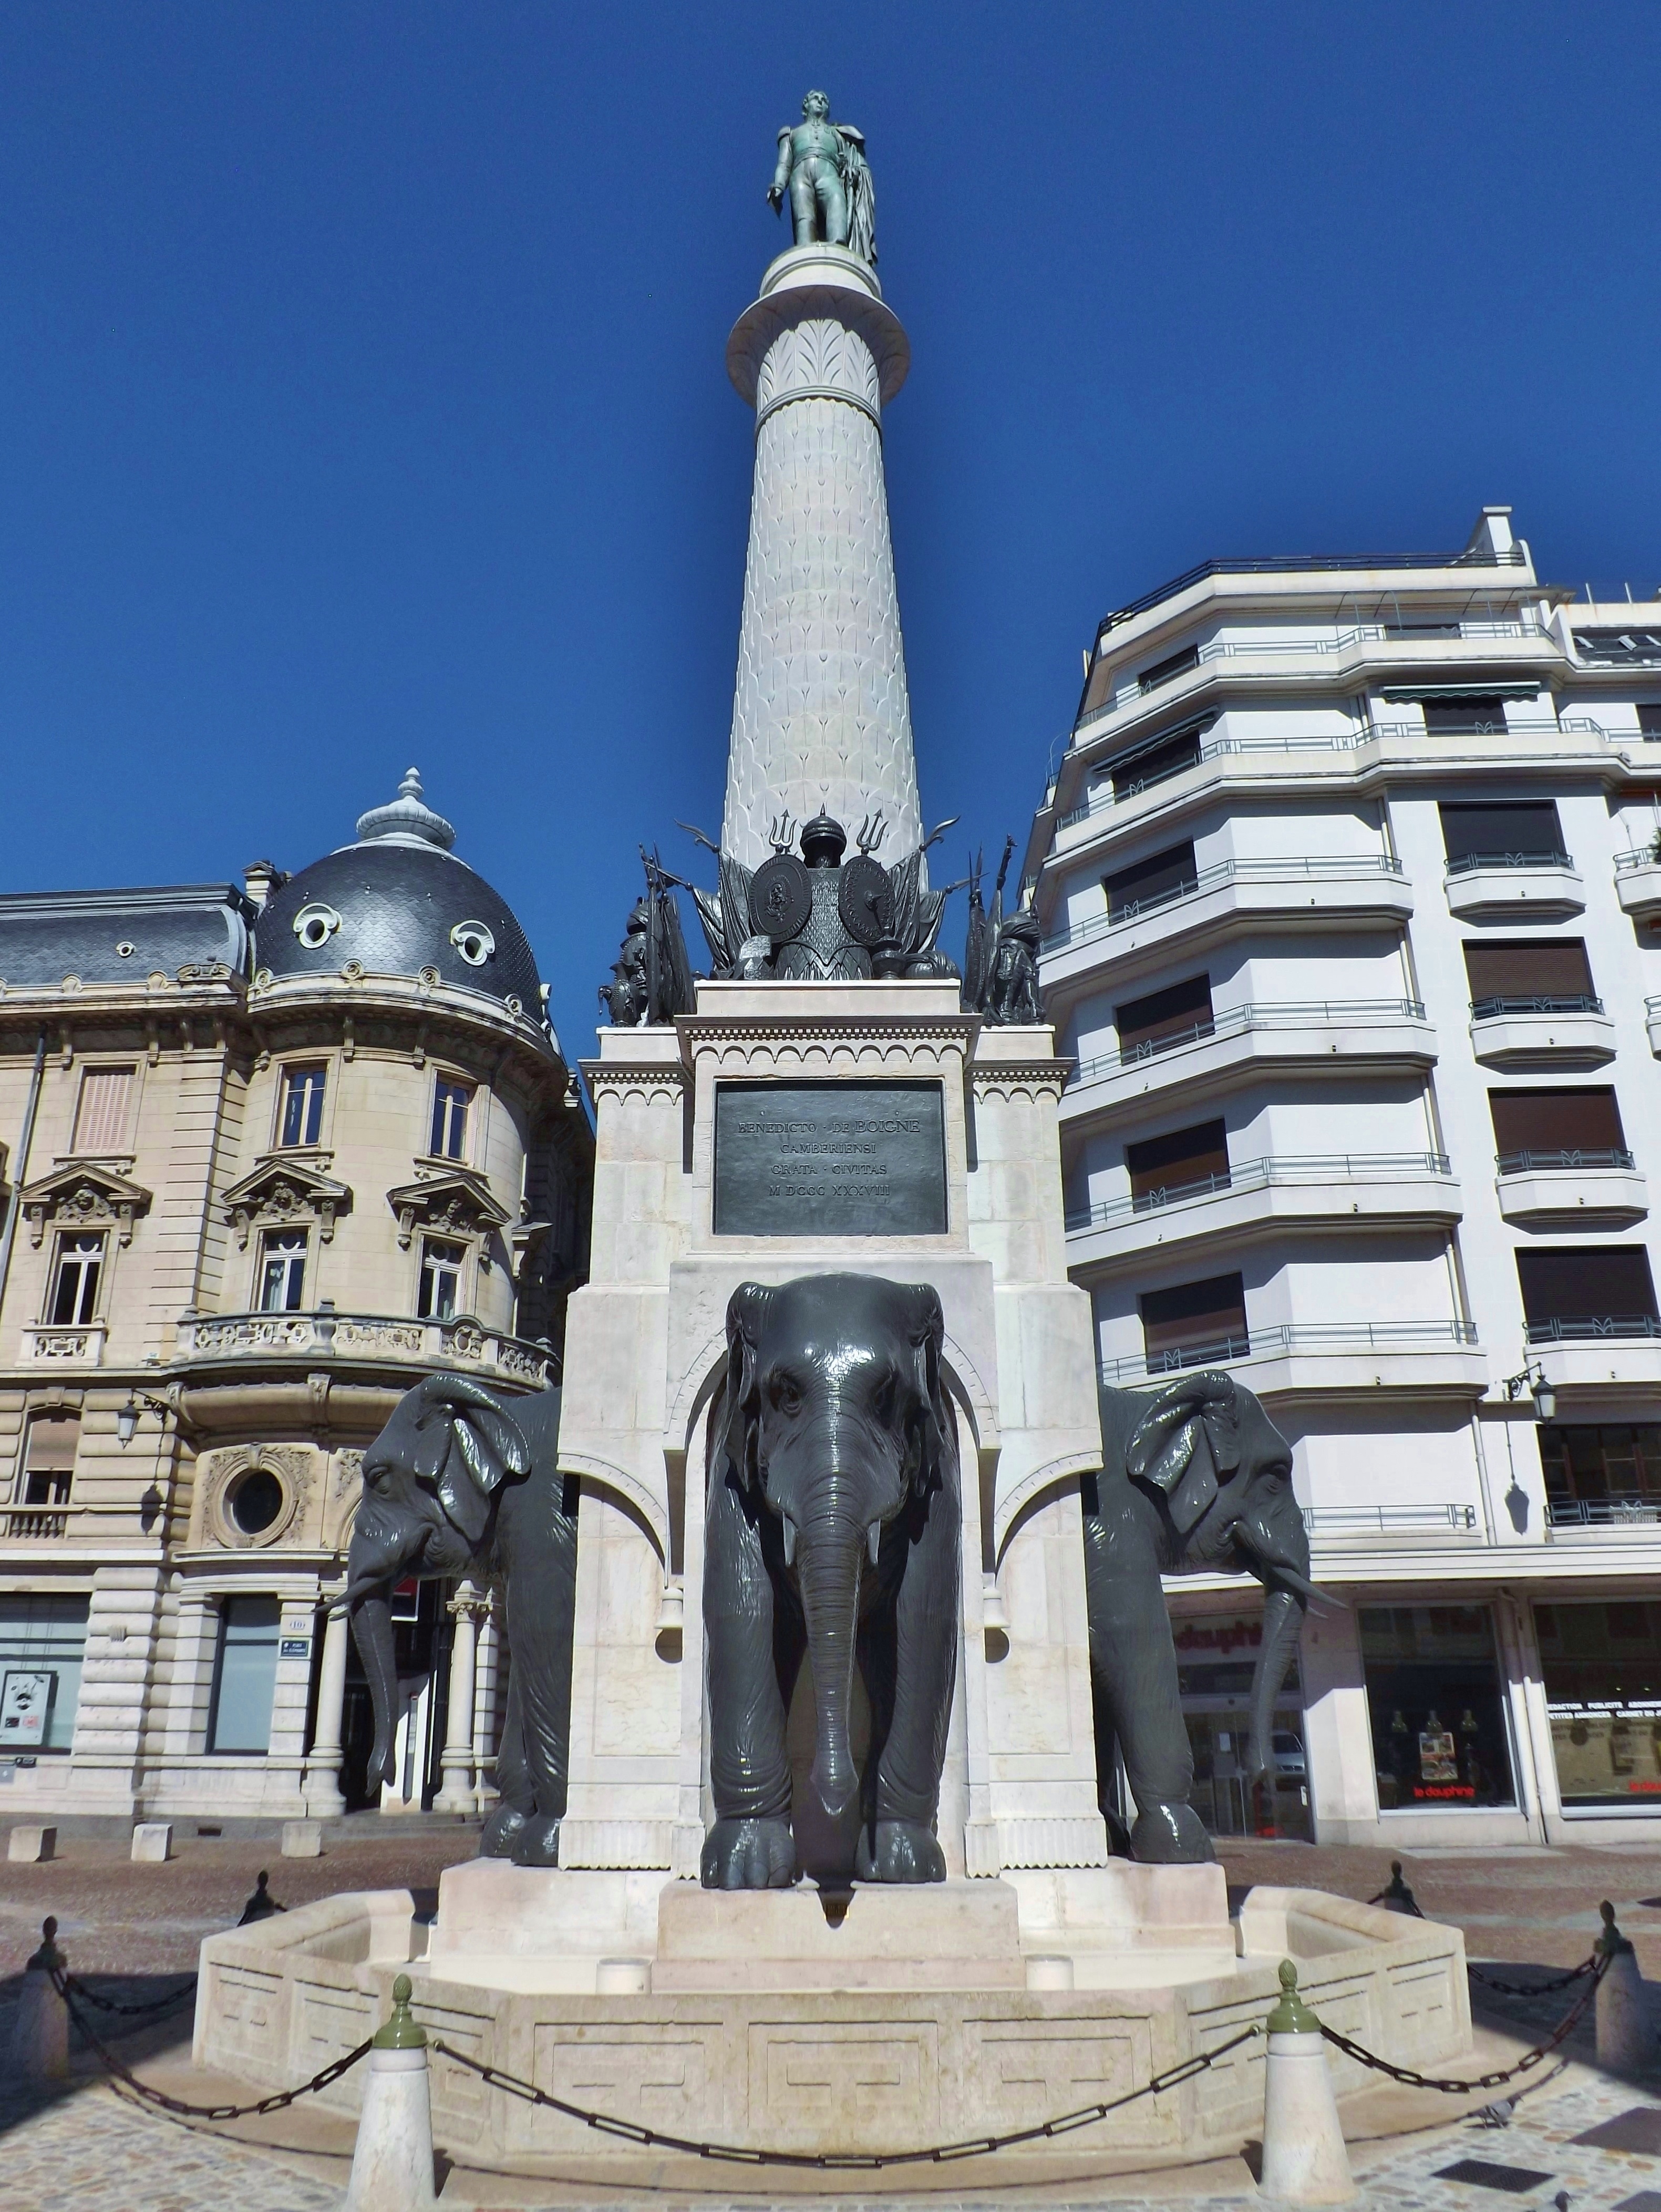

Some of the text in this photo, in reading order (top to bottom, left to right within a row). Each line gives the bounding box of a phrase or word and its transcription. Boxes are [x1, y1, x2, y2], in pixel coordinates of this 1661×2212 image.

[738, 1120, 920, 1134] BENEDICTO DE BOIGNE
[780, 1143, 876, 1154] CAMBERIENSI
[771, 1164, 888, 1175] GRATA CIVITAS
[769, 1185, 891, 1196] M DCCC XXXVIII
